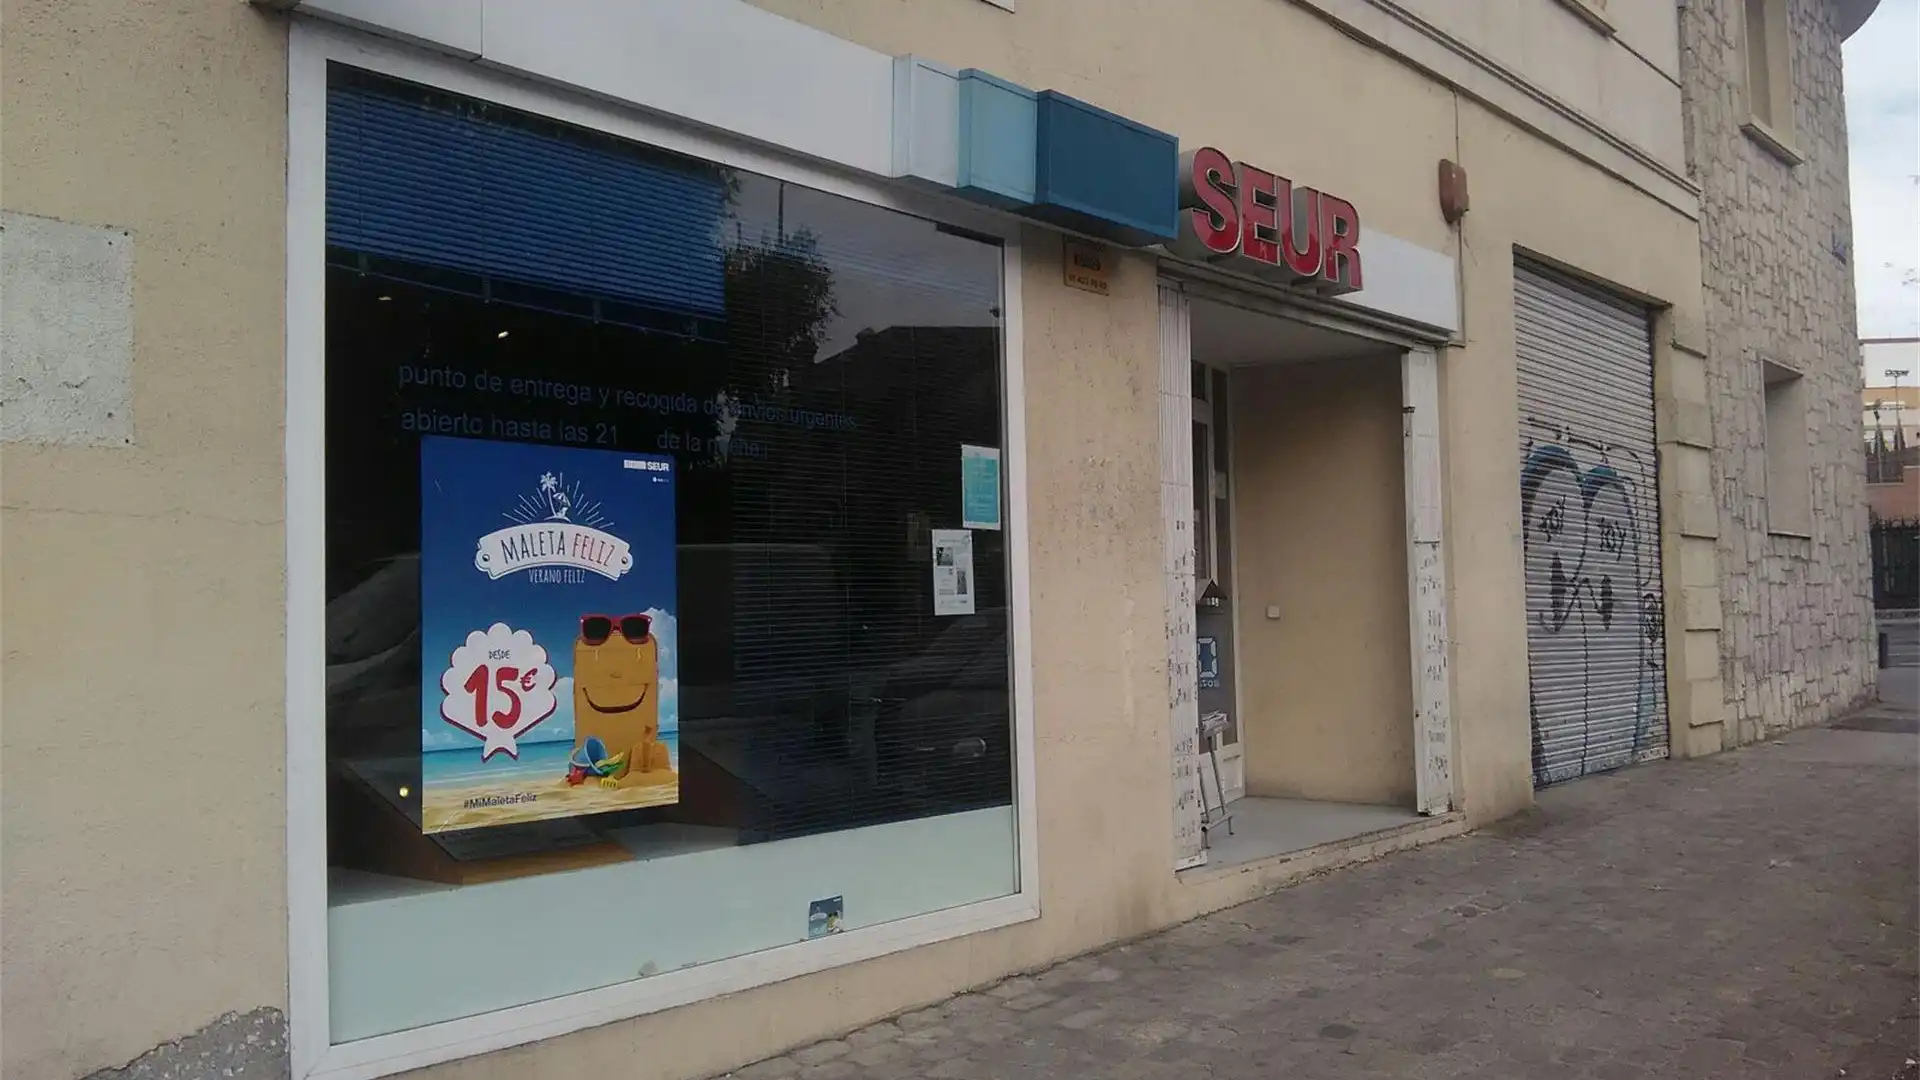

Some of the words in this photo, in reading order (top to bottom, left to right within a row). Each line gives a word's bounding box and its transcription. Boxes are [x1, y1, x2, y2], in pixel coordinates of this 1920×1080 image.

[1191, 146, 1363, 291] SEUR
[399, 364, 466, 389] punto
[474, 368, 503, 392] de
[510, 377, 591, 405] entrega
[598, 387, 610, 408] y
[616, 390, 698, 415] recogida
[401, 407, 483, 434] abierto
[492, 413, 551, 439] hasta
[560, 419, 589, 443] las
[596, 422, 618, 445] 21
[656, 429, 680, 449] de
[686, 431, 701, 452] la
[647, 461, 669, 472] SEUR
[501, 531, 566, 565] MALETA
[571, 533, 615, 567] FELIZ
[528, 568, 562, 583] VERANO
[563, 569, 586, 583] FELIZ
[488, 649, 511, 661] DESDE
[463, 792, 537, 809] #MiMaletaFeliz
